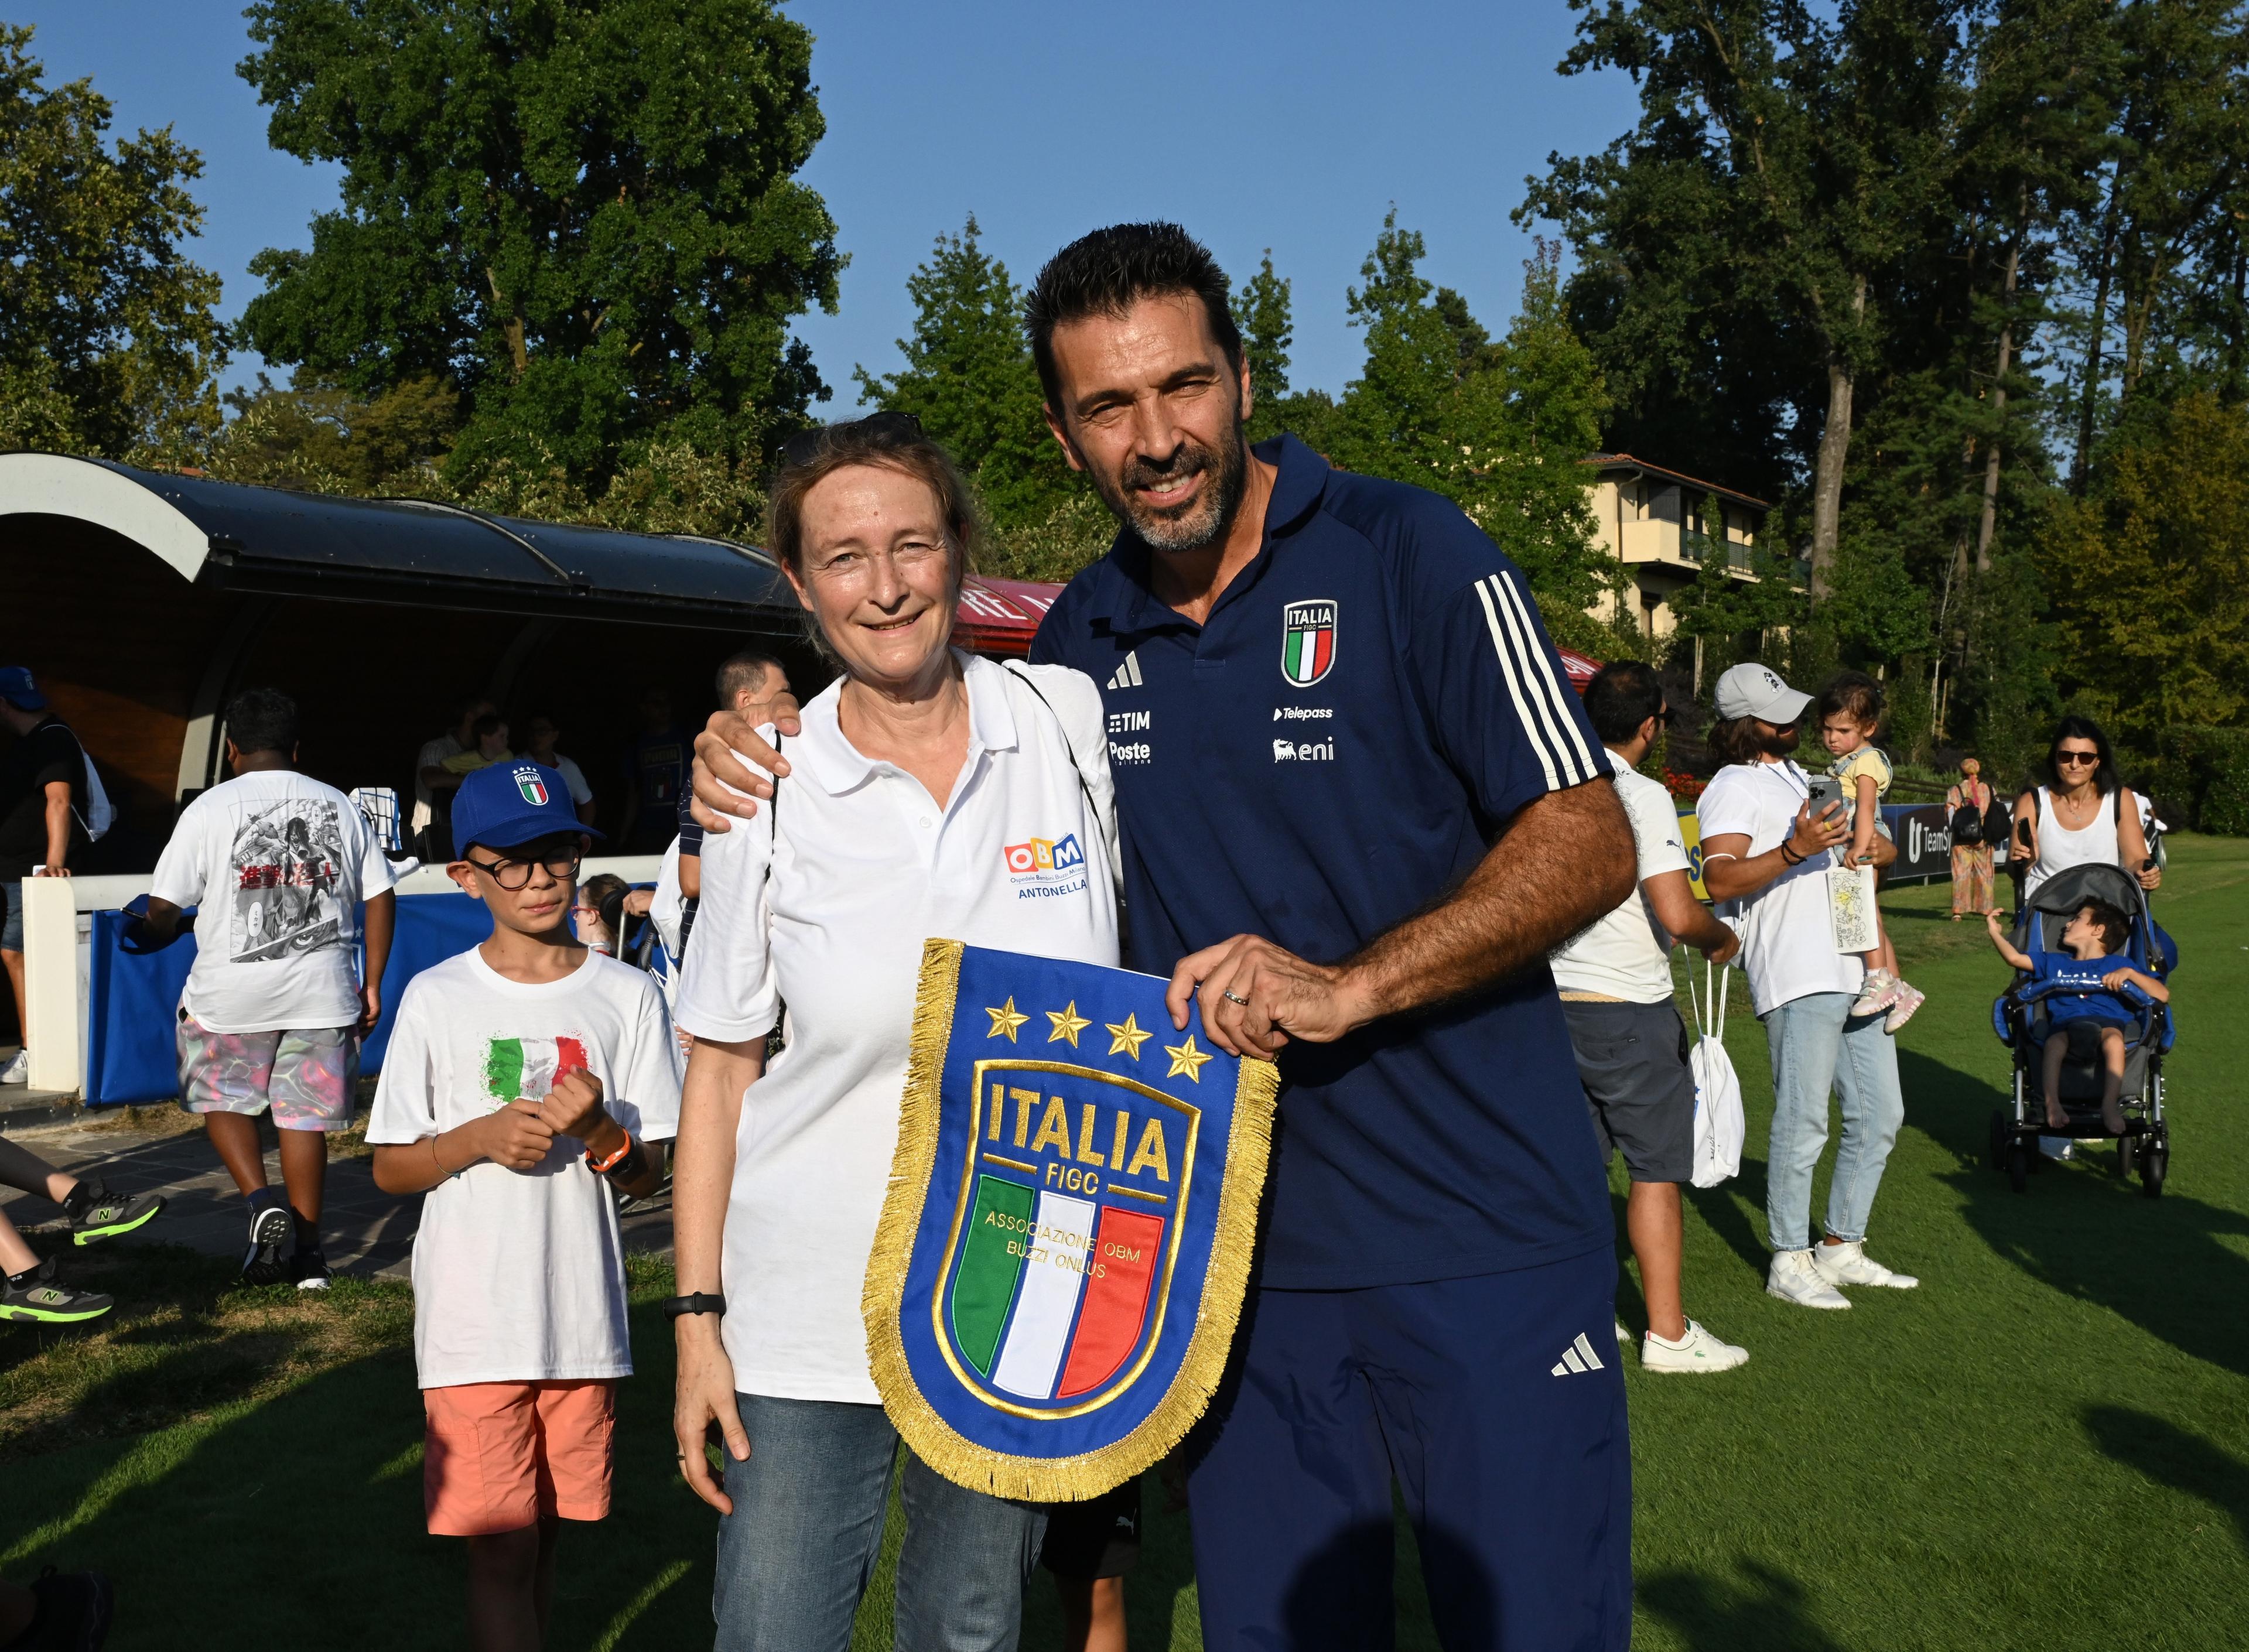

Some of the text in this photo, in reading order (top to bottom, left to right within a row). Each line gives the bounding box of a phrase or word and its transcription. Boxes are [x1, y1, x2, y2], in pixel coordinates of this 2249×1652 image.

[1288, 608, 1332, 625] ITALIA
[1122, 710, 1150, 731] TIM
[1283, 706, 1333, 721] Telepass
[1109, 741, 1151, 760] Poste
[1298, 736, 1334, 760] eni
[517, 775, 540, 784] ITALIA
[1923, 825, 1953, 857] TeamSy
[1009, 840, 1081, 870] OBM
[1010, 875, 1035, 884] Ospedale
[1069, 866, 1086, 875] Milano
[1018, 879, 1088, 899] ANTONELLA
[987, 1083, 1170, 1182] ITALIA
[1044, 1162, 1099, 1195] FIGC
[98, 1208, 111, 1221] N
[985, 1210, 1140, 1264] ASSOCIAZIONE OBM
[1006, 1240, 1106, 1278] BUZZI ONLUS
[40, 1290, 60, 1303] N
